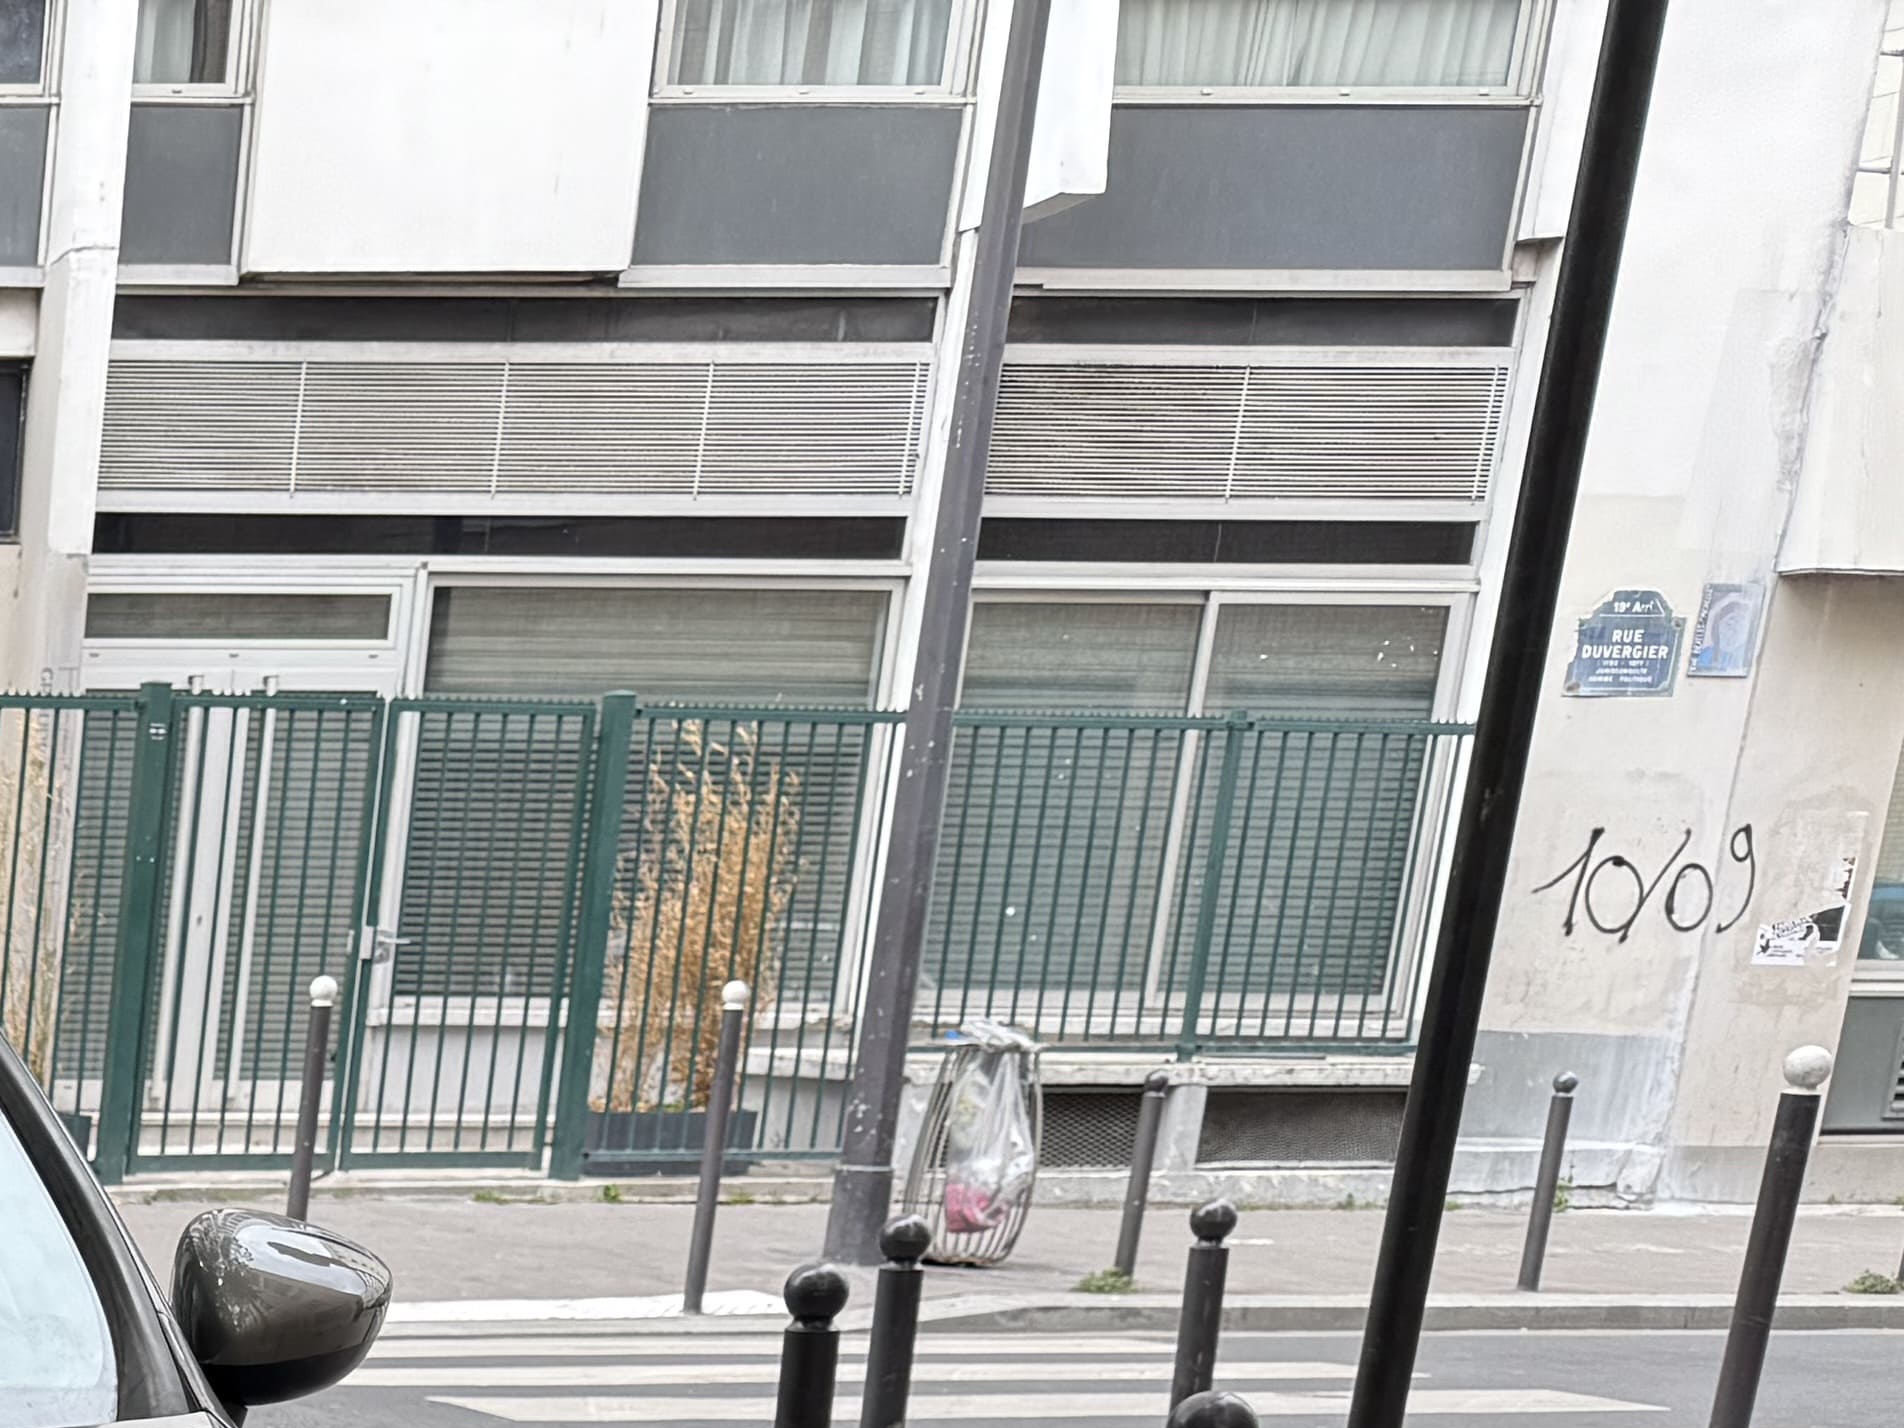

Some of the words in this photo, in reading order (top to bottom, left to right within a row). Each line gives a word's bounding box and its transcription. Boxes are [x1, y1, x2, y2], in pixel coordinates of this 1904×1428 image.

[1612, 629, 1645, 643] RUE
[1581, 645, 1669, 660] DUVERGIER
[1531, 823, 1756, 943] 10/09
